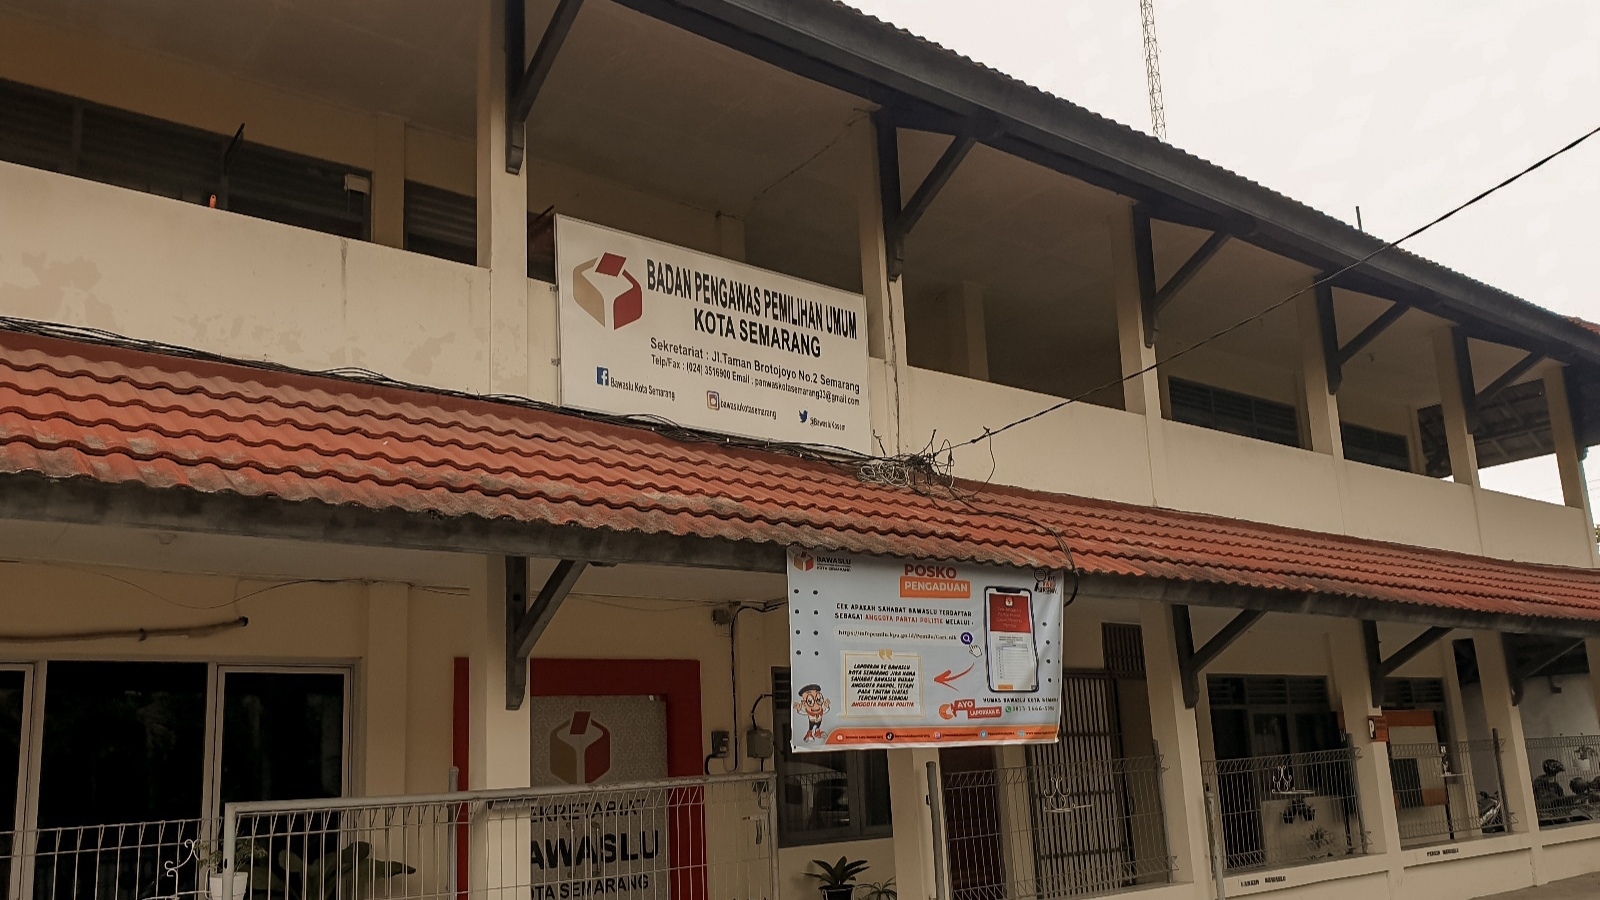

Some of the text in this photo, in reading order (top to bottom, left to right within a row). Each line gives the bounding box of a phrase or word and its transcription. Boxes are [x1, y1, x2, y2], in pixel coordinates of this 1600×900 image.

[646, 258, 857, 340] BADAN PENGAWAS PEMILIHAN UMUM
[693, 308, 821, 358] KOTA SEMARANG
[650, 336, 703, 359] Sekretariat
[754, 359, 797, 380] Brotojoyo
[798, 369, 818, 384] No.2
[820, 374, 860, 395] Semarang
[651, 353, 681, 369] Telp/Fax
[732, 371, 750, 384] Email
[610, 376, 675, 401] Bawaslu Kota Semarang
[816, 556, 851, 565] BAWASLU
[904, 564, 957, 579] POSKO
[904, 580, 968, 593] PENGADUAN
[834, 612, 863, 620] SEBAGAI
[865, 614, 894, 622] ANGGOTA
[945, 618, 970, 626] MELALUI
[836, 602, 972, 617] CEK APAKAH SAHABAT BAWASLU TERDAFTAR
[957, 701, 973, 709] AYO
[1368, 719, 1374, 738] P
[531, 798, 646, 823] EKRETARIAT
[531, 829, 659, 870] AWASLU
[531, 873, 649, 900] TA SEMARANG
